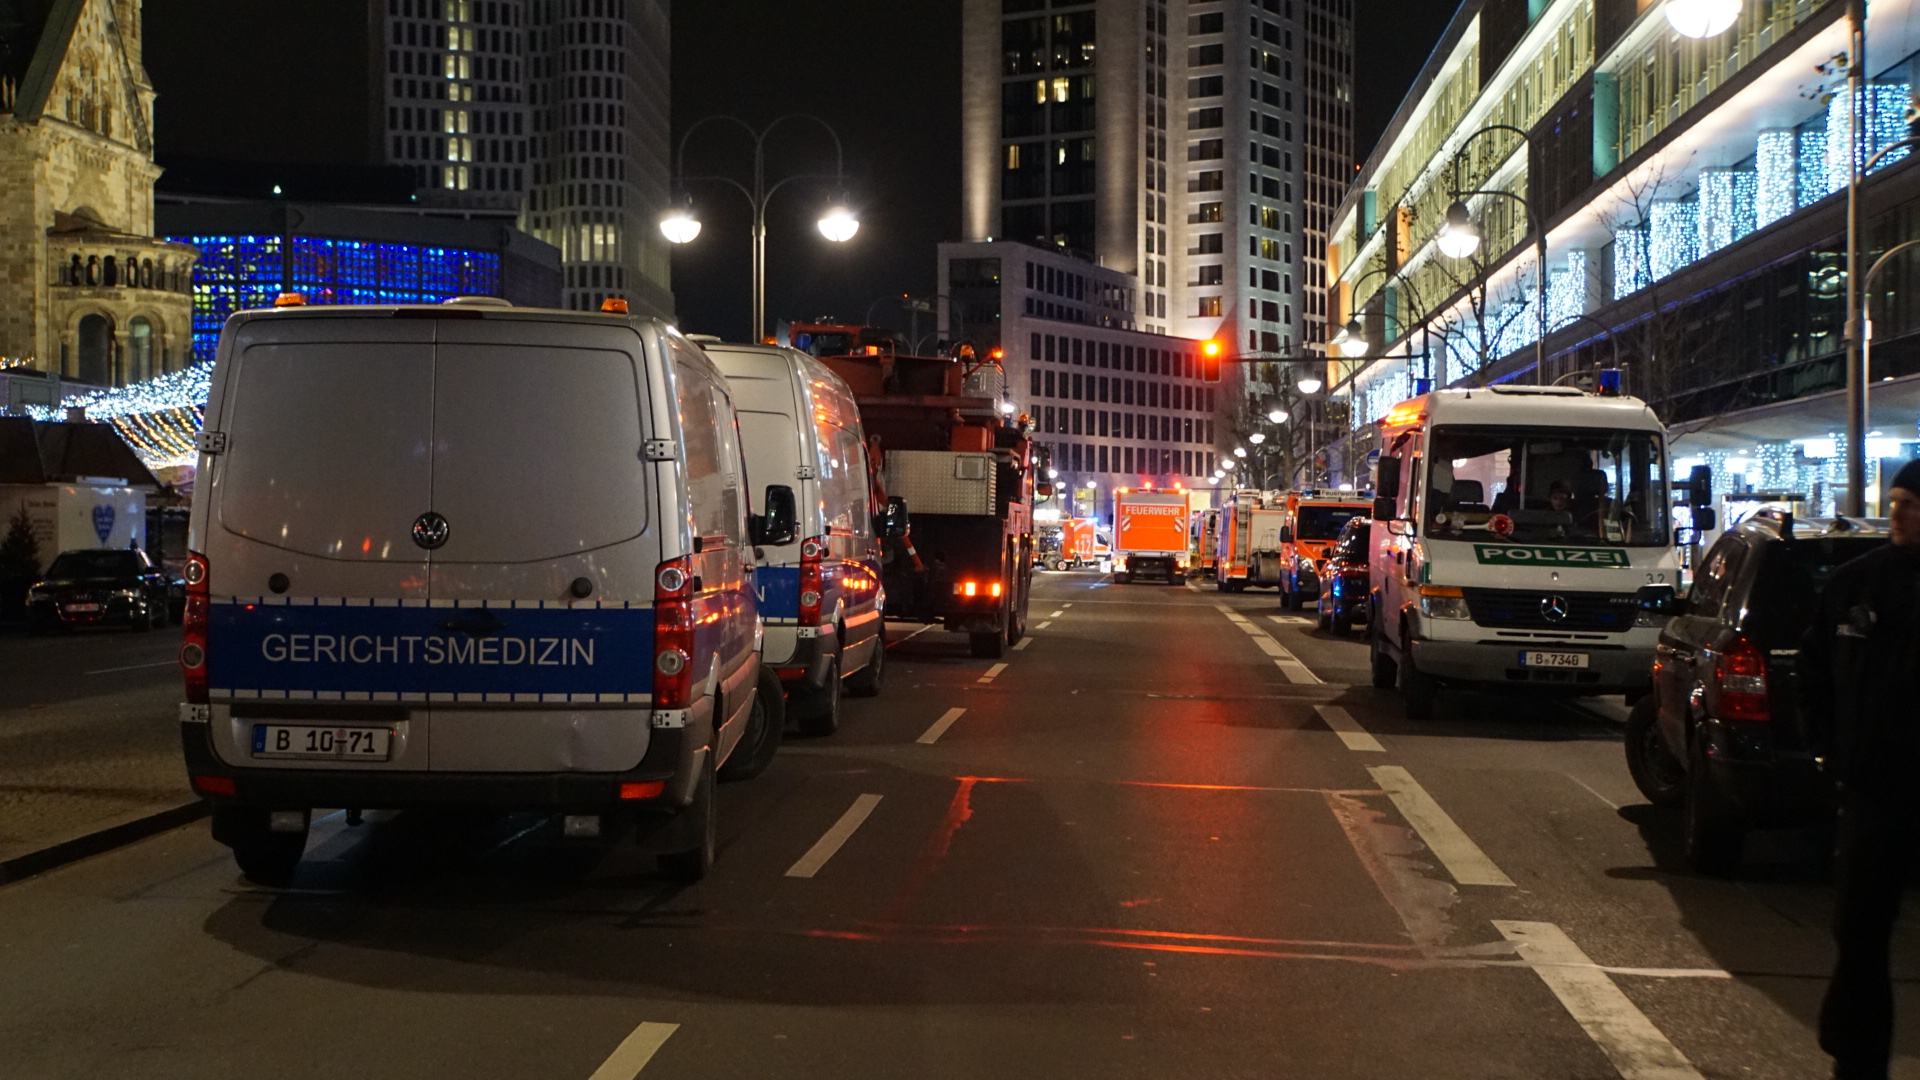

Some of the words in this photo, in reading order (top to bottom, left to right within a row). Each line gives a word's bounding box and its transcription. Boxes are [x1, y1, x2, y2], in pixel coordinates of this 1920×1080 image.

[1125, 506, 1180, 516] FEUERWEHR
[1074, 538, 1091, 554] 112
[1482, 548, 1623, 563] POLIZEI
[262, 633, 595, 666] GERICHTSMEDIZIN
[1535, 653, 1544, 665] B
[276, 729, 290, 751] B
